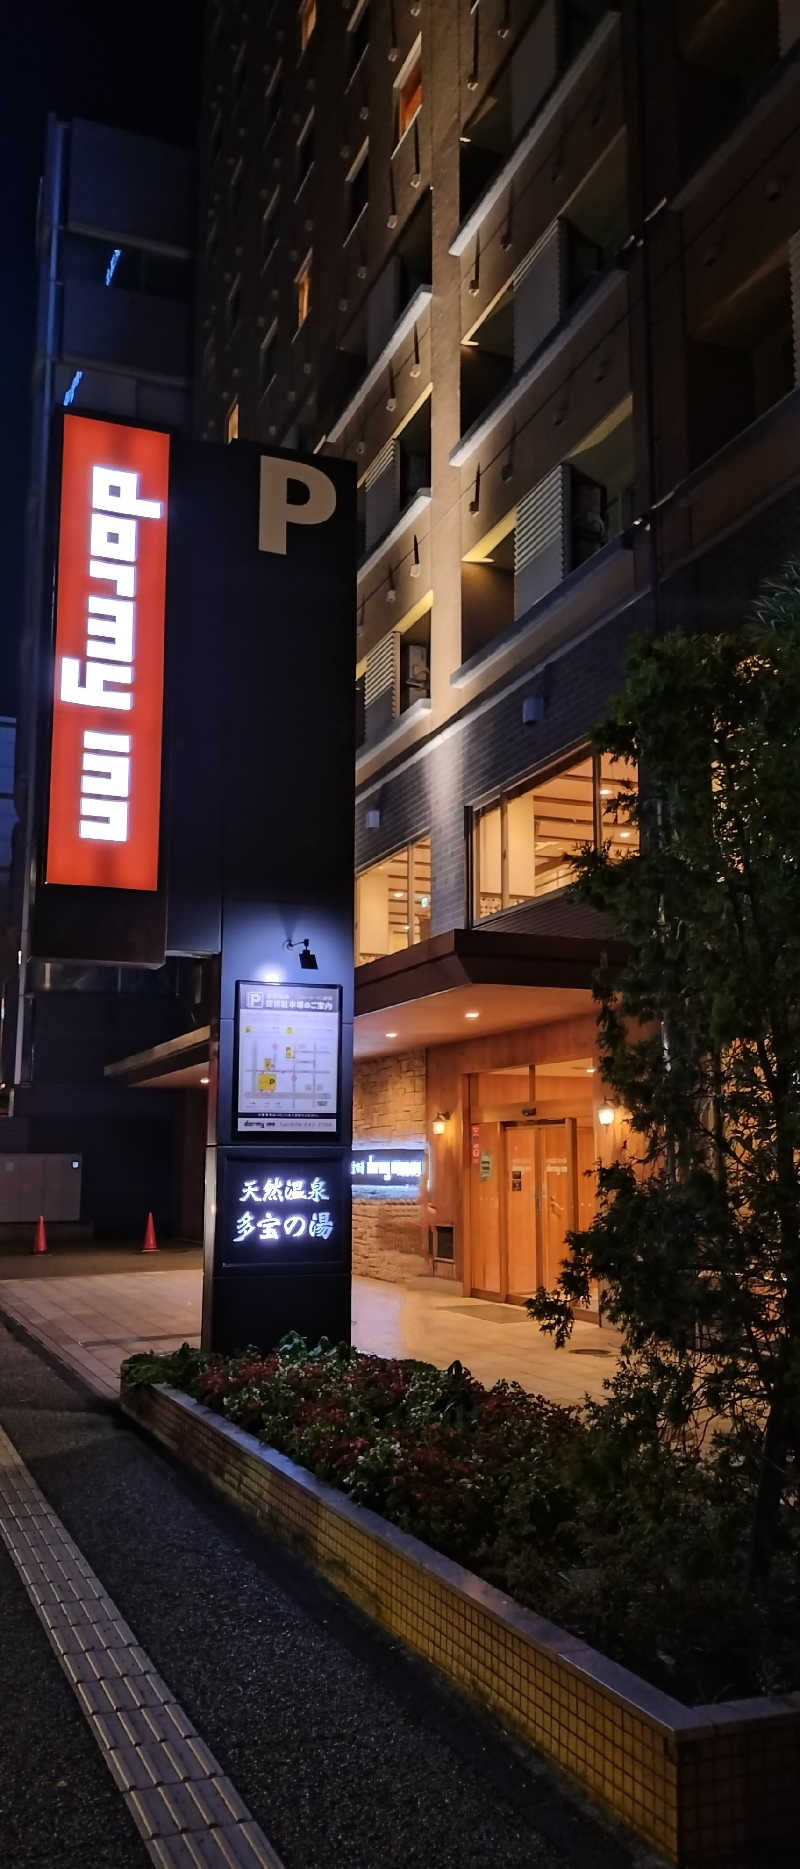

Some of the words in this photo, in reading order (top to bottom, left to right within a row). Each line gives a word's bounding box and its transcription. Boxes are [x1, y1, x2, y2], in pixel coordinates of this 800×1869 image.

[258, 455, 336, 555] P
[60, 465, 162, 711] dormy
[78, 729, 132, 842] inn
[233, 1211, 333, 1242] 多宝の湯
[239, 1177, 330, 1202] 天然温泉
